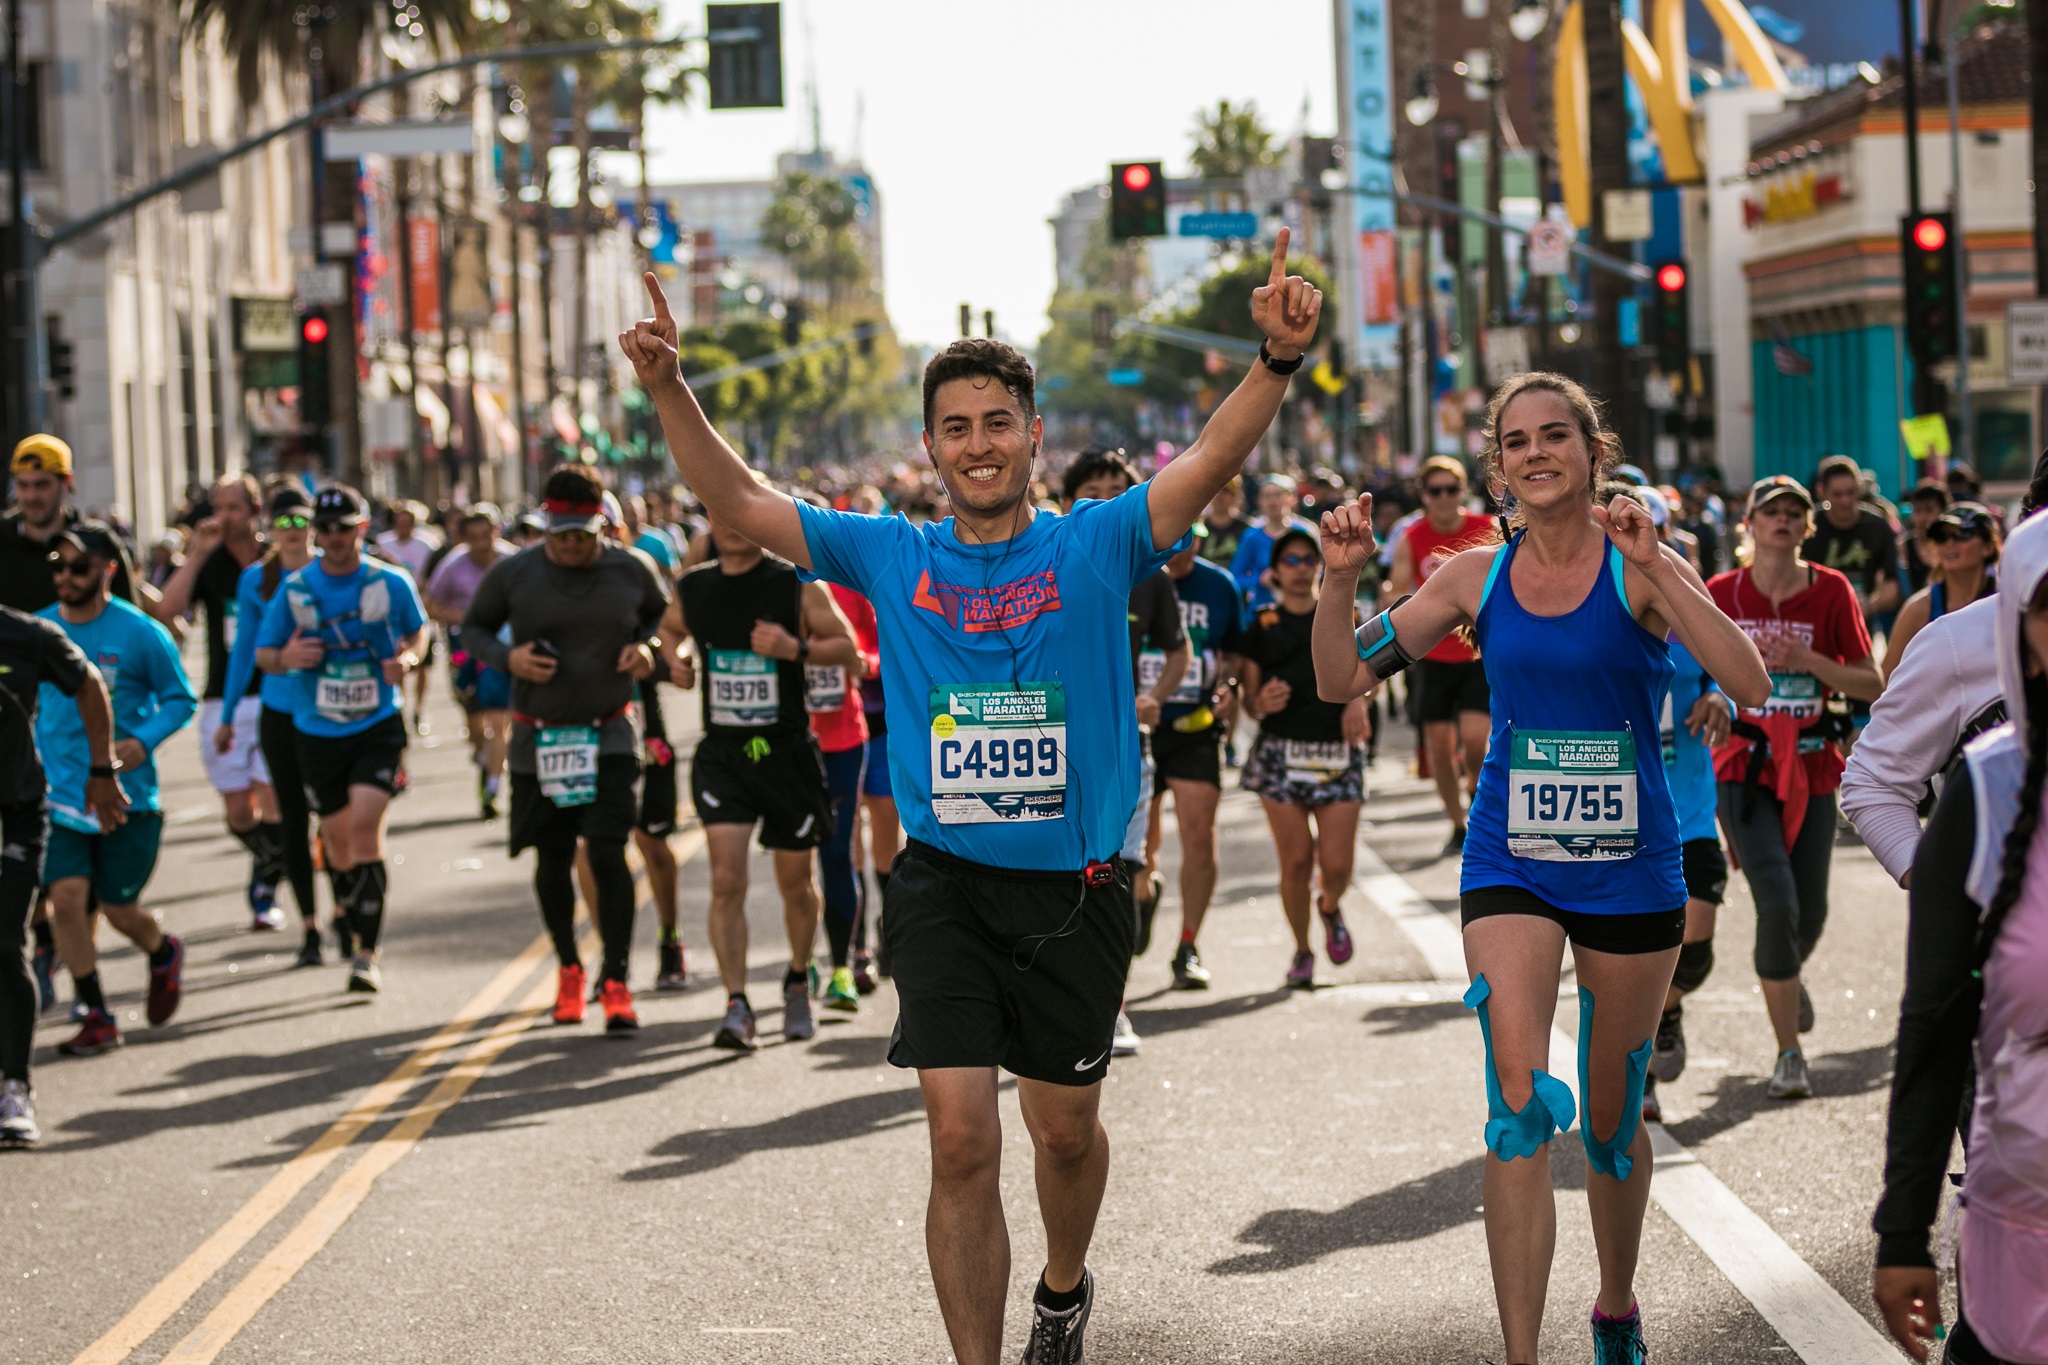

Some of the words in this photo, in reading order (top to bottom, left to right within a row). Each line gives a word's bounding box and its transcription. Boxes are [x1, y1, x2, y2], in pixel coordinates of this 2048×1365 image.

[715, 680, 768, 700] 19978
[983, 704, 1046, 714] MARATHON
[1578, 745, 1618, 753] ANGELES
[940, 737, 1057, 779] C4999
[1559, 752, 1619, 762] MARATHON
[1521, 783, 1623, 822] 19755
